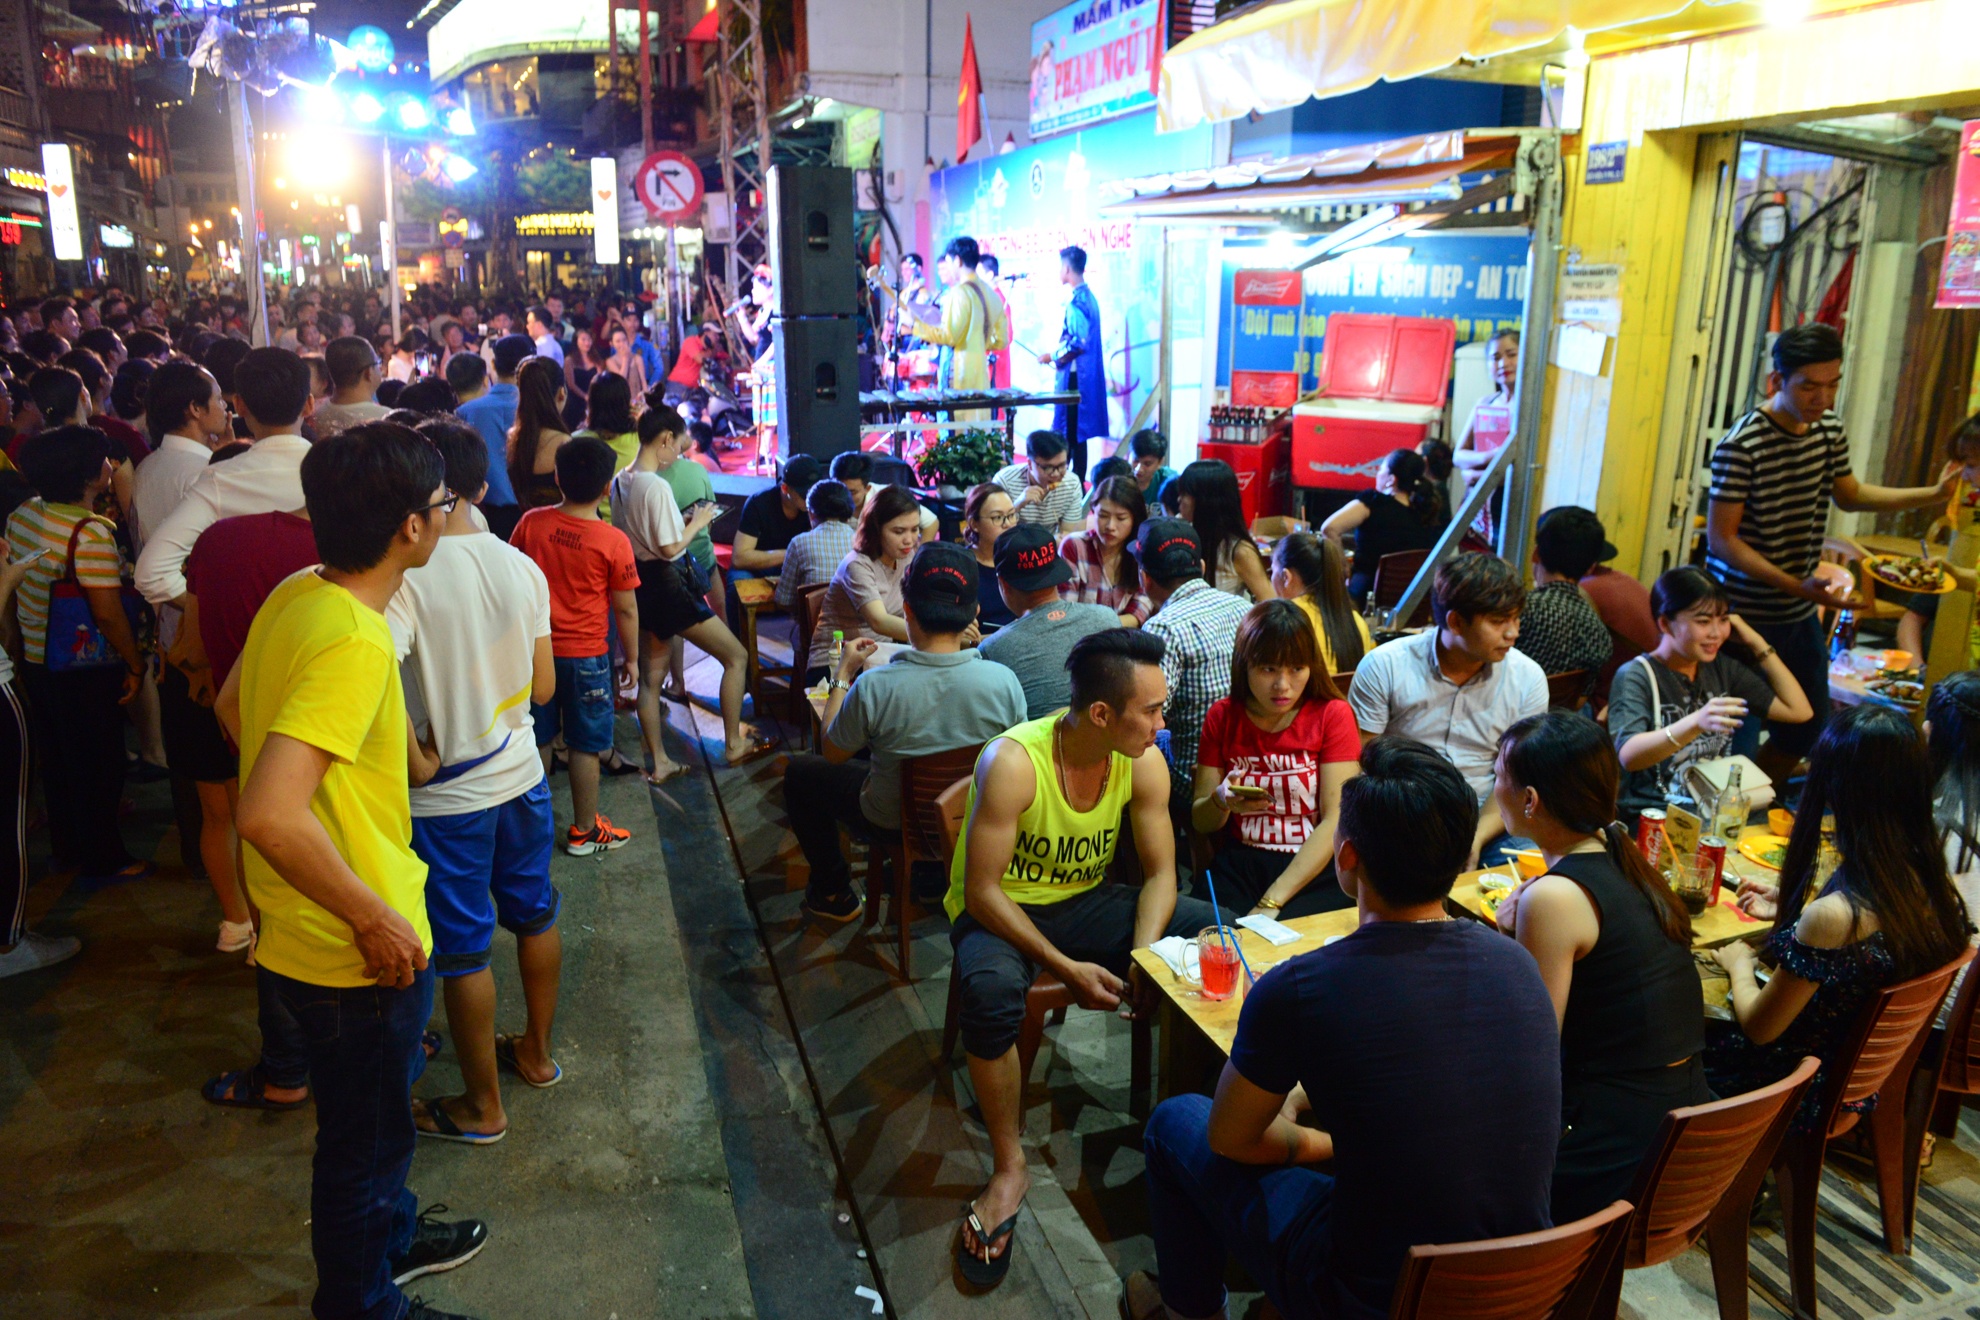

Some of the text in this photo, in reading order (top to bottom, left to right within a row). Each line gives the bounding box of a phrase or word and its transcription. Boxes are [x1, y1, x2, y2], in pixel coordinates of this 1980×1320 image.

[1475, 264, 1503, 300] AN
[1505, 264, 1528, 301] TO
[1017, 541, 1055, 563] MADE
[1016, 828, 1115, 864] NO MONE
[1009, 853, 1107, 884] NO HONE
